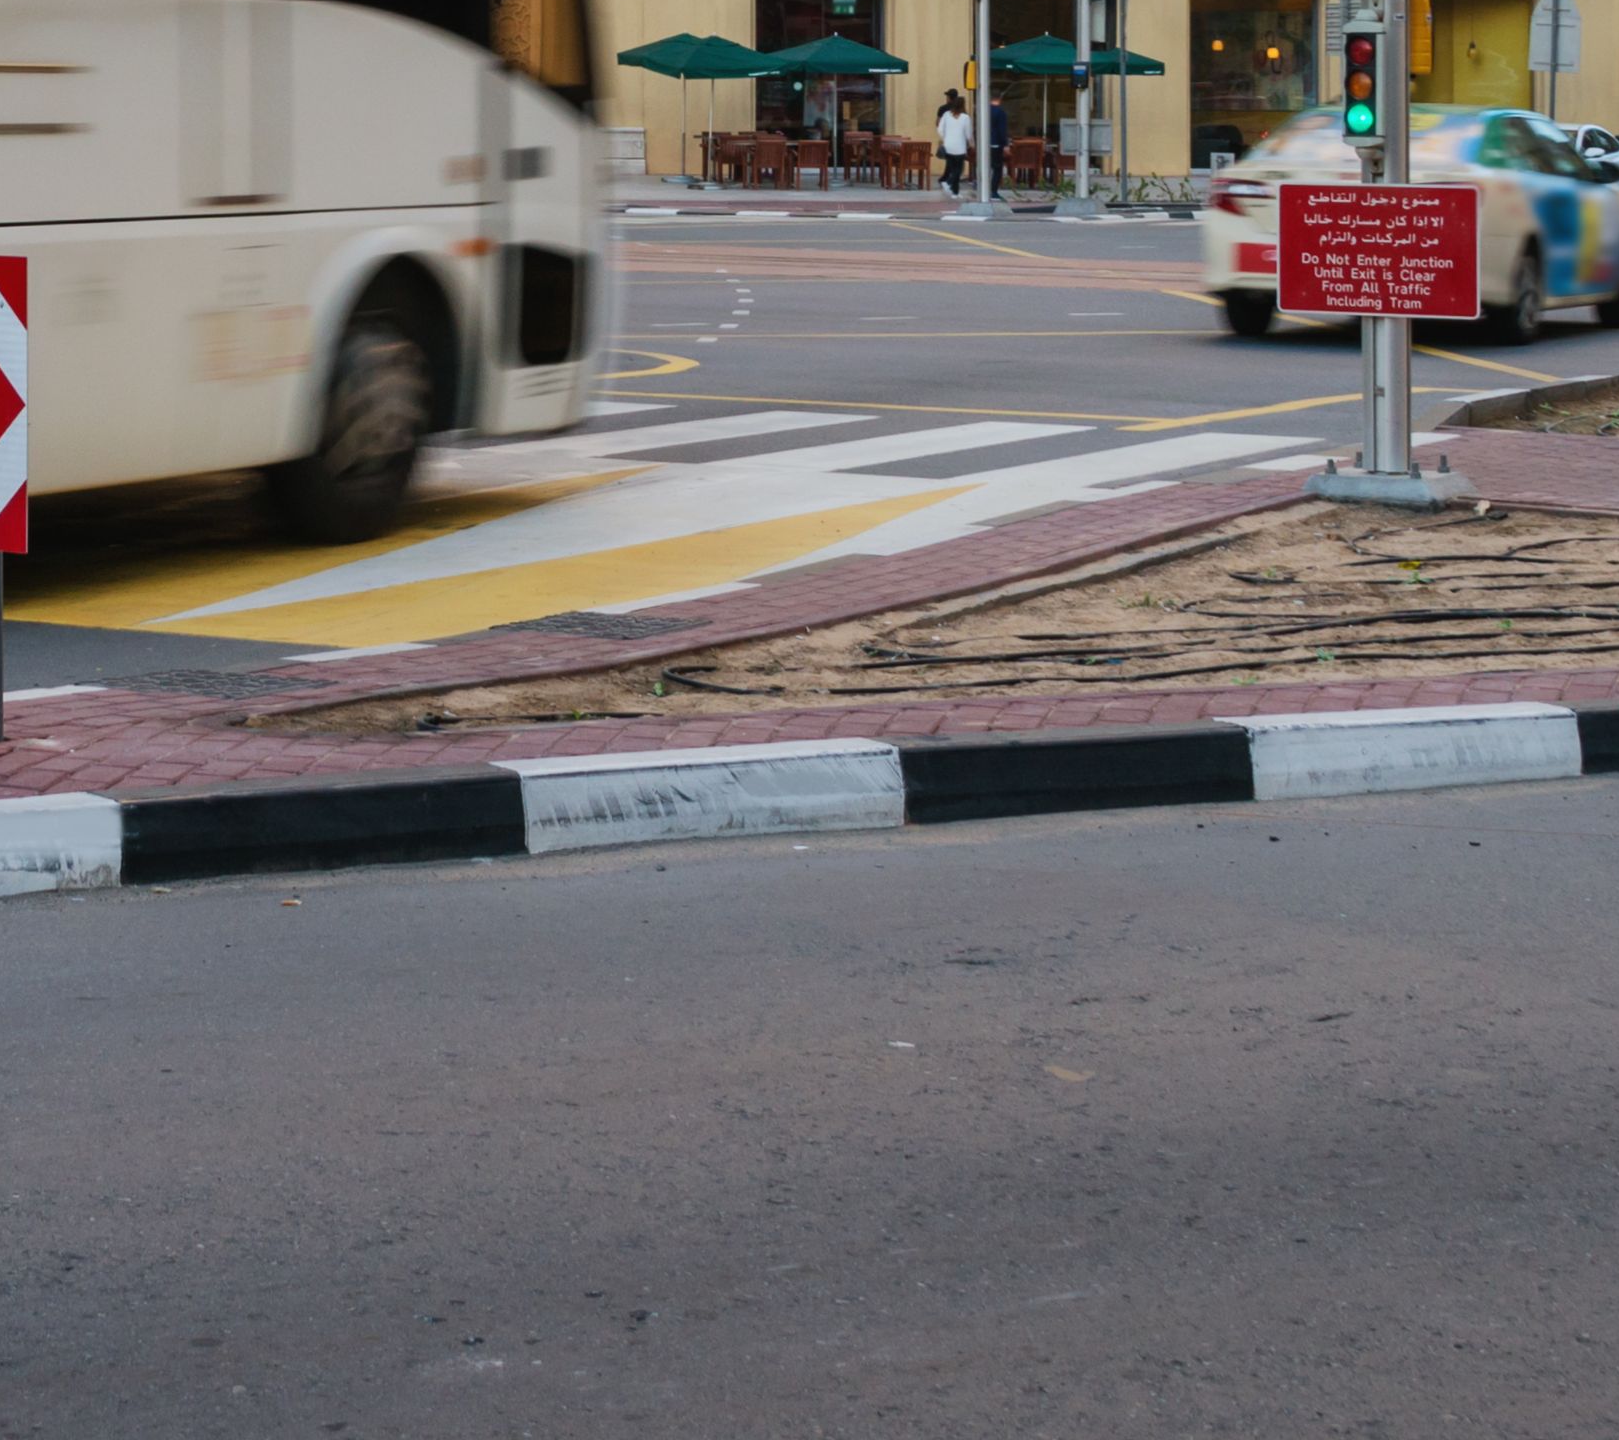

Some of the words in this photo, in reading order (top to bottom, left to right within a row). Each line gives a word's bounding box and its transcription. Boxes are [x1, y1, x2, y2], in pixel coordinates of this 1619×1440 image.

[1308, 192, 1356, 206] التقاطع
[1361, 192, 1397, 206] دخول
[1402, 194, 1439, 209] ممنوع
[1338, 215, 1380, 228] مسارك
[1386, 216, 1406, 228] كان
[1319, 231, 1357, 246] والترام
[1361, 233, 1416, 247] المركبات
[1421, 237, 1439, 247] من
[1302, 253, 1319, 264] Do
[1326, 254, 1349, 265] Not
[1357, 255, 1391, 267] Enter
[1400, 256, 1453, 268] Junction
[1314, 267, 1344, 278] Until
[1351, 268, 1375, 280] Exit
[1383, 269, 1393, 280] is
[1400, 270, 1436, 281] Clear
[1322, 281, 1353, 292] From
[1361, 282, 1379, 293] All
[1387, 283, 1431, 295] Traffic
[1327, 295, 1382, 310] Including
[1390, 297, 1422, 309] Tram
